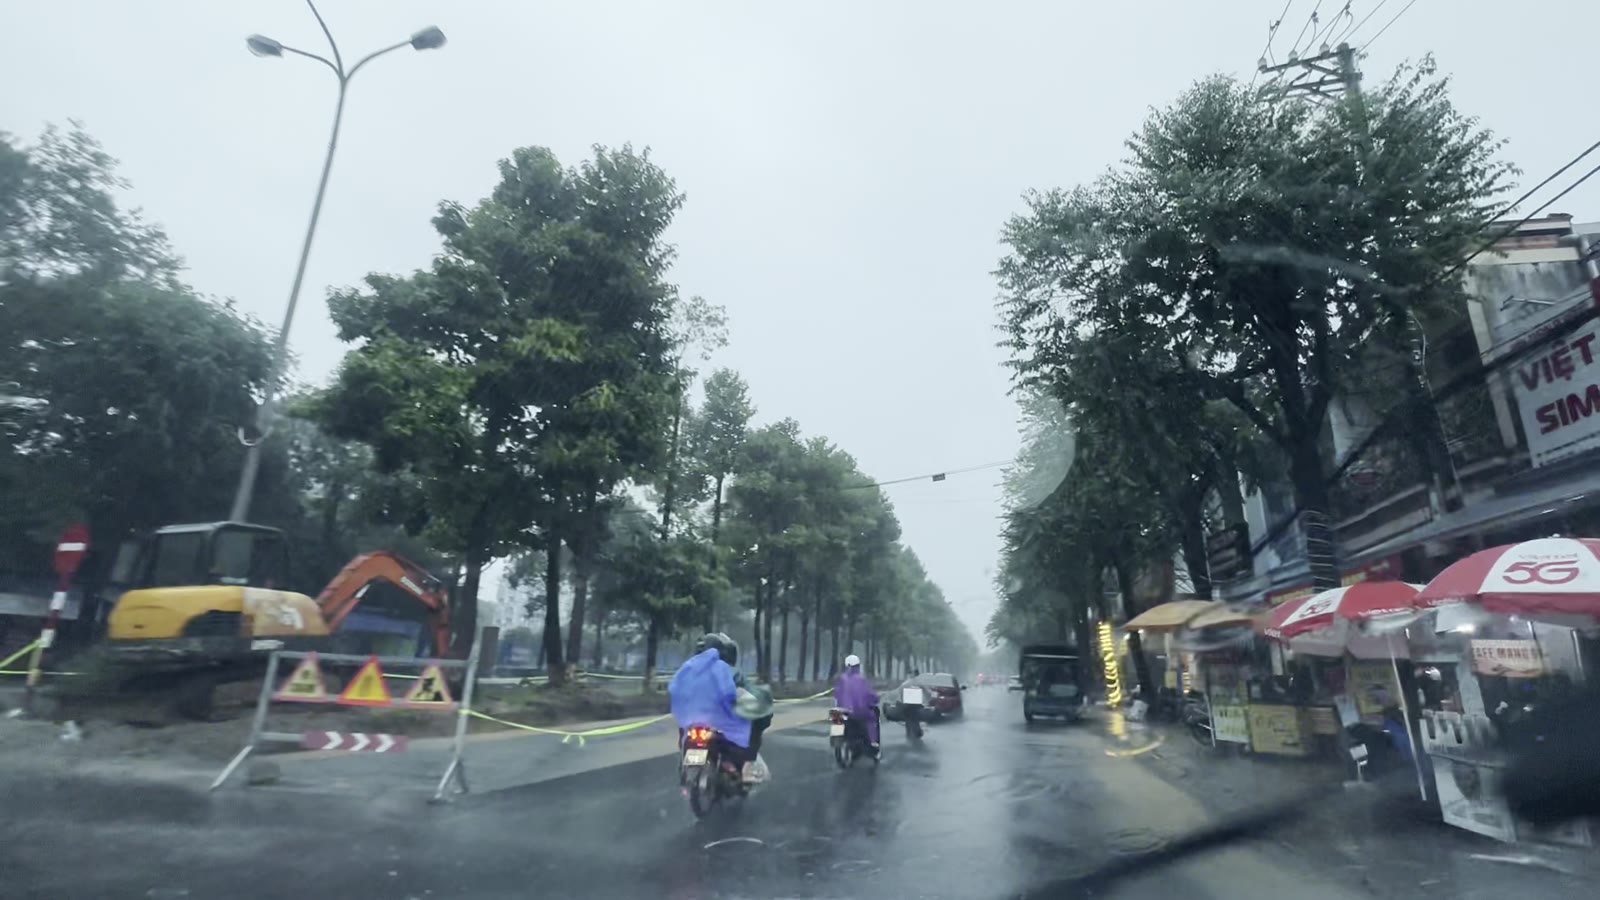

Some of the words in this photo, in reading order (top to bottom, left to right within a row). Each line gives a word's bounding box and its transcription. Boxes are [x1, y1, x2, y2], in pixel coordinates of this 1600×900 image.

[1520, 332, 1595, 391] VIỆT
[1536, 384, 1600, 434] SIM
[1503, 559, 1580, 584] 5G
